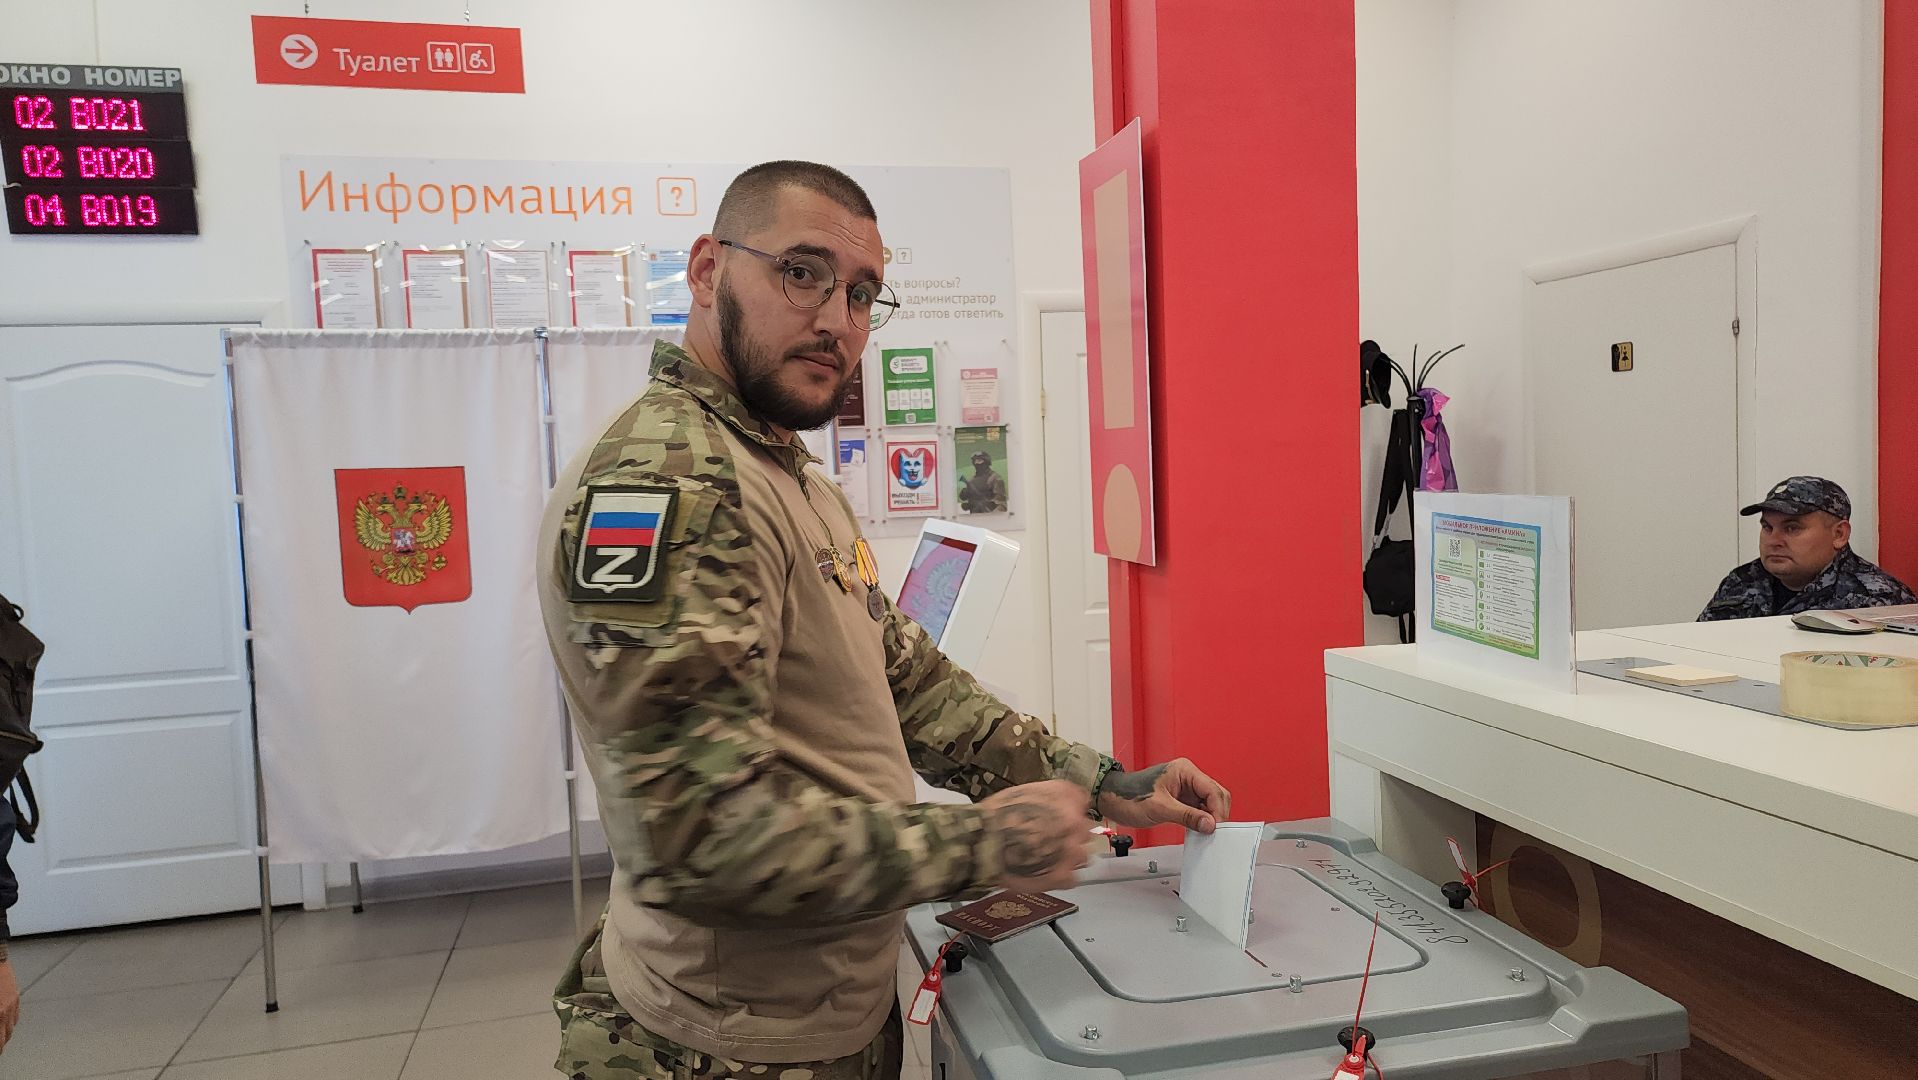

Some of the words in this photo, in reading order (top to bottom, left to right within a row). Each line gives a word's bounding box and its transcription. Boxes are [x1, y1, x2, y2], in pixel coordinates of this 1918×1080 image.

[332, 48, 420, 77] Туалет
[84, 67, 181, 88] НОМЕР
[14, 95, 57, 129] 02
[70, 96, 146, 131] В021
[21, 145, 64, 178] 02
[77, 146, 156, 179] В020
[24, 194, 67, 227] 04
[80, 194, 159, 227] В019
[299, 170, 633, 225] Информация
[904, 277, 961, 290] вопросы?
[906, 294, 996, 305] администратор
[919, 311, 950, 320] готов
[954, 309, 1004, 320] ответить
[590, 547, 639, 583] Z
[954, 911, 1001, 931] ПАСПОРТ
